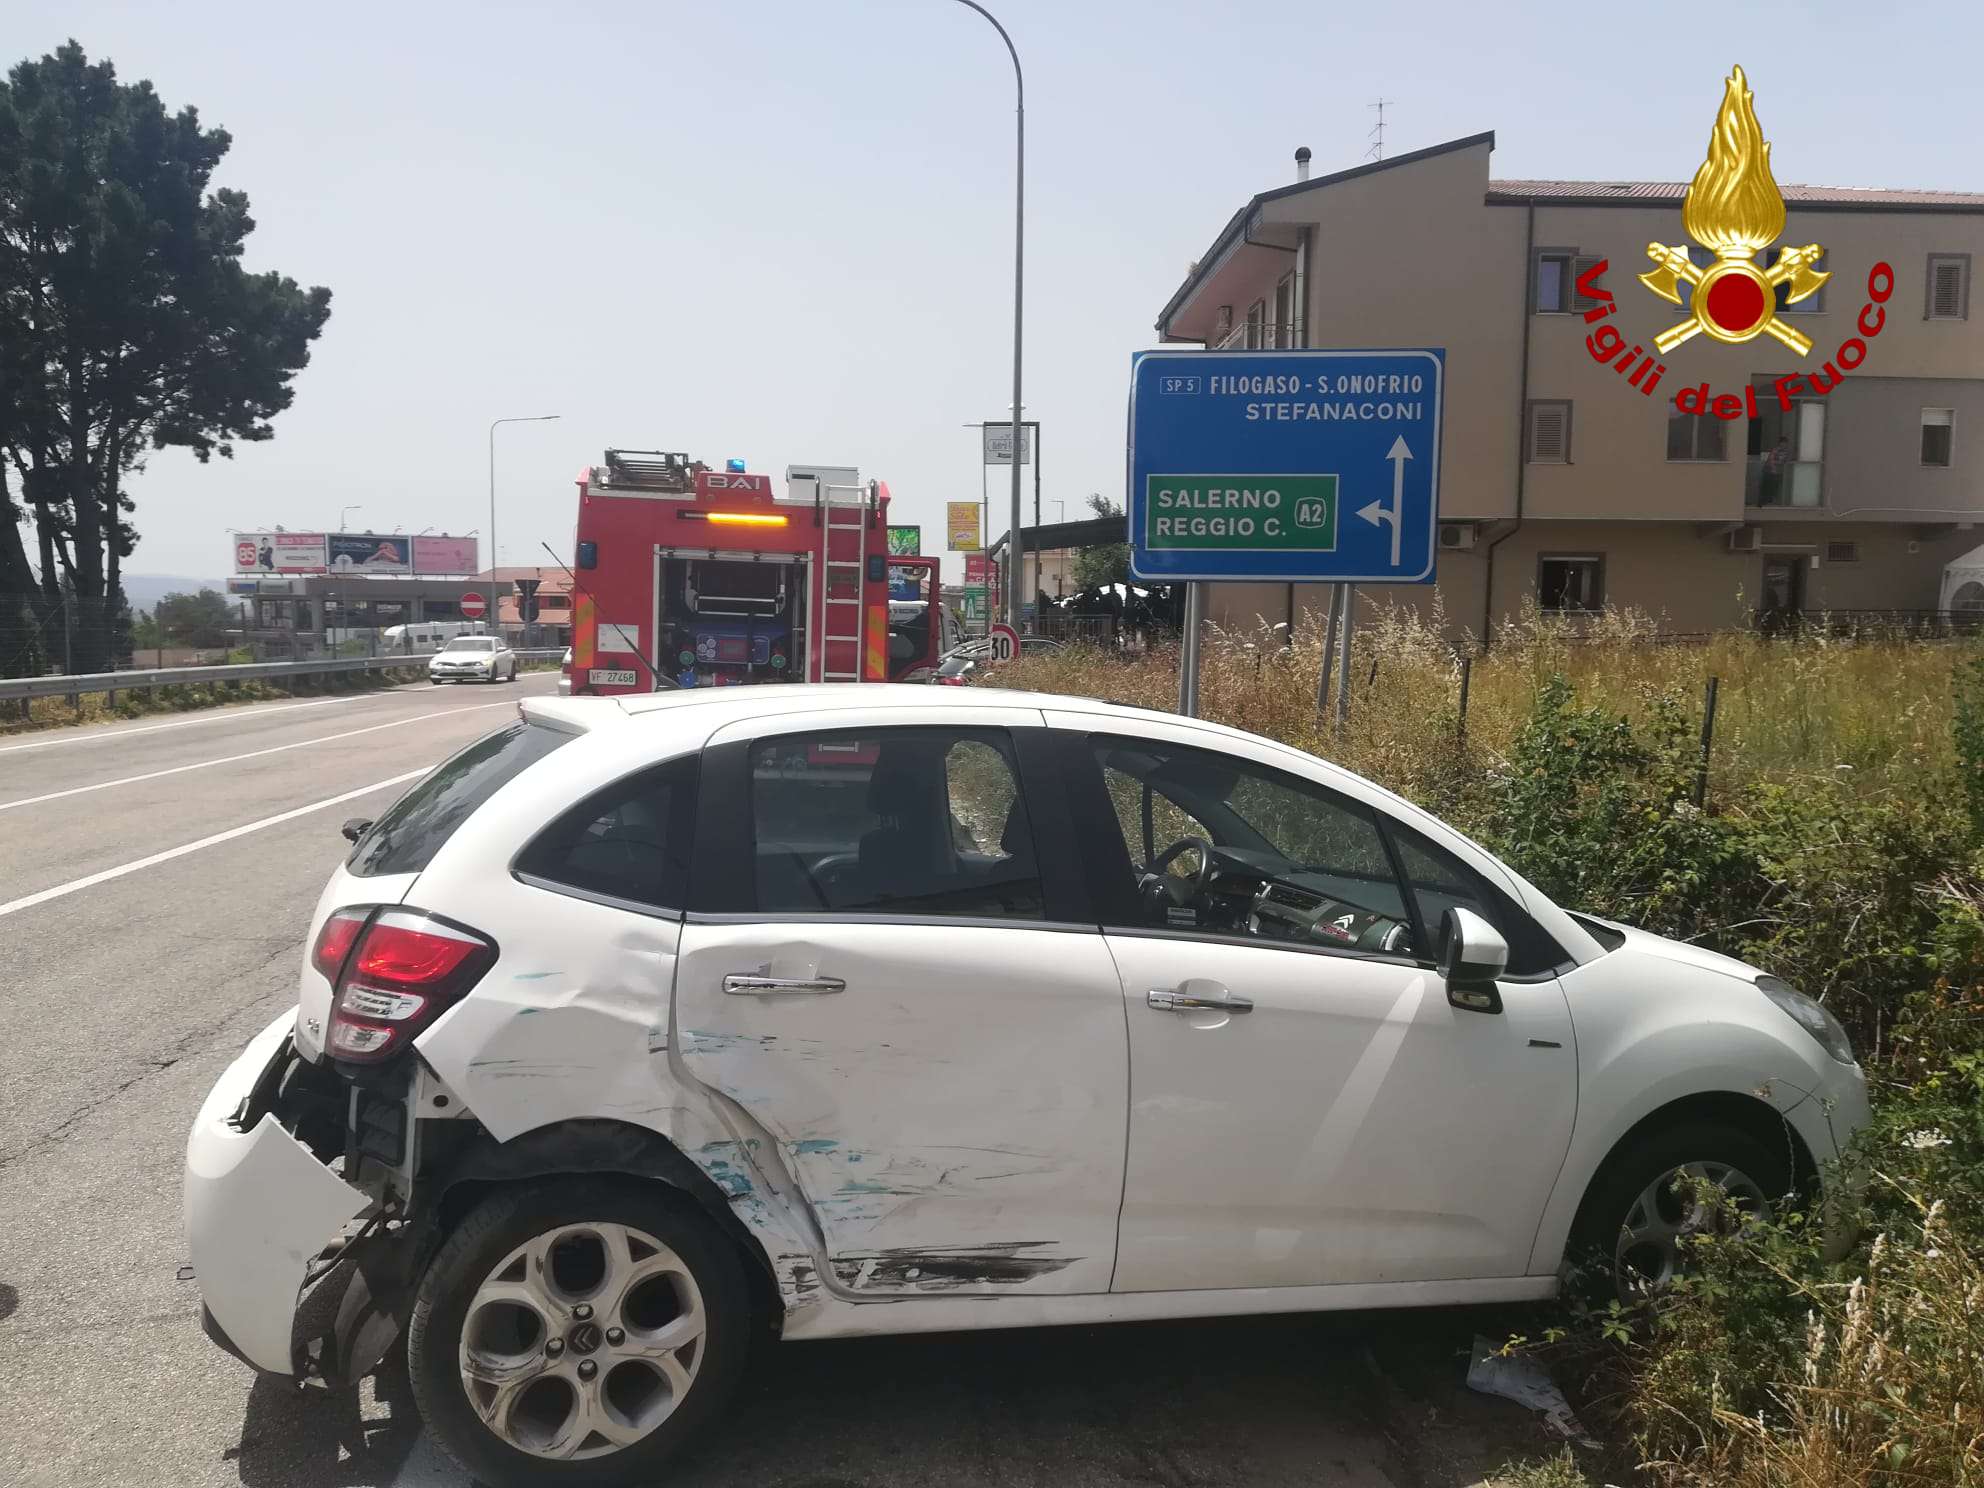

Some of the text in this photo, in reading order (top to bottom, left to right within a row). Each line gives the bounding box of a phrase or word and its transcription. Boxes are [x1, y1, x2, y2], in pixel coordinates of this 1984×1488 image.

[1166, 379, 1194, 392] SP 5
[1210, 375, 1299, 395] FILOGASO
[1318, 375, 1423, 394] S.ONOFRIO
[1245, 402, 1423, 420] STEFANACONI
[707, 475, 760, 490] BAI
[1157, 489, 1281, 508] SALERNO
[1299, 503, 1322, 523] A2
[1156, 517, 1287, 536] REGGIO C.
[991, 637, 1010, 660] 30
[591, 671, 602, 681] VF
